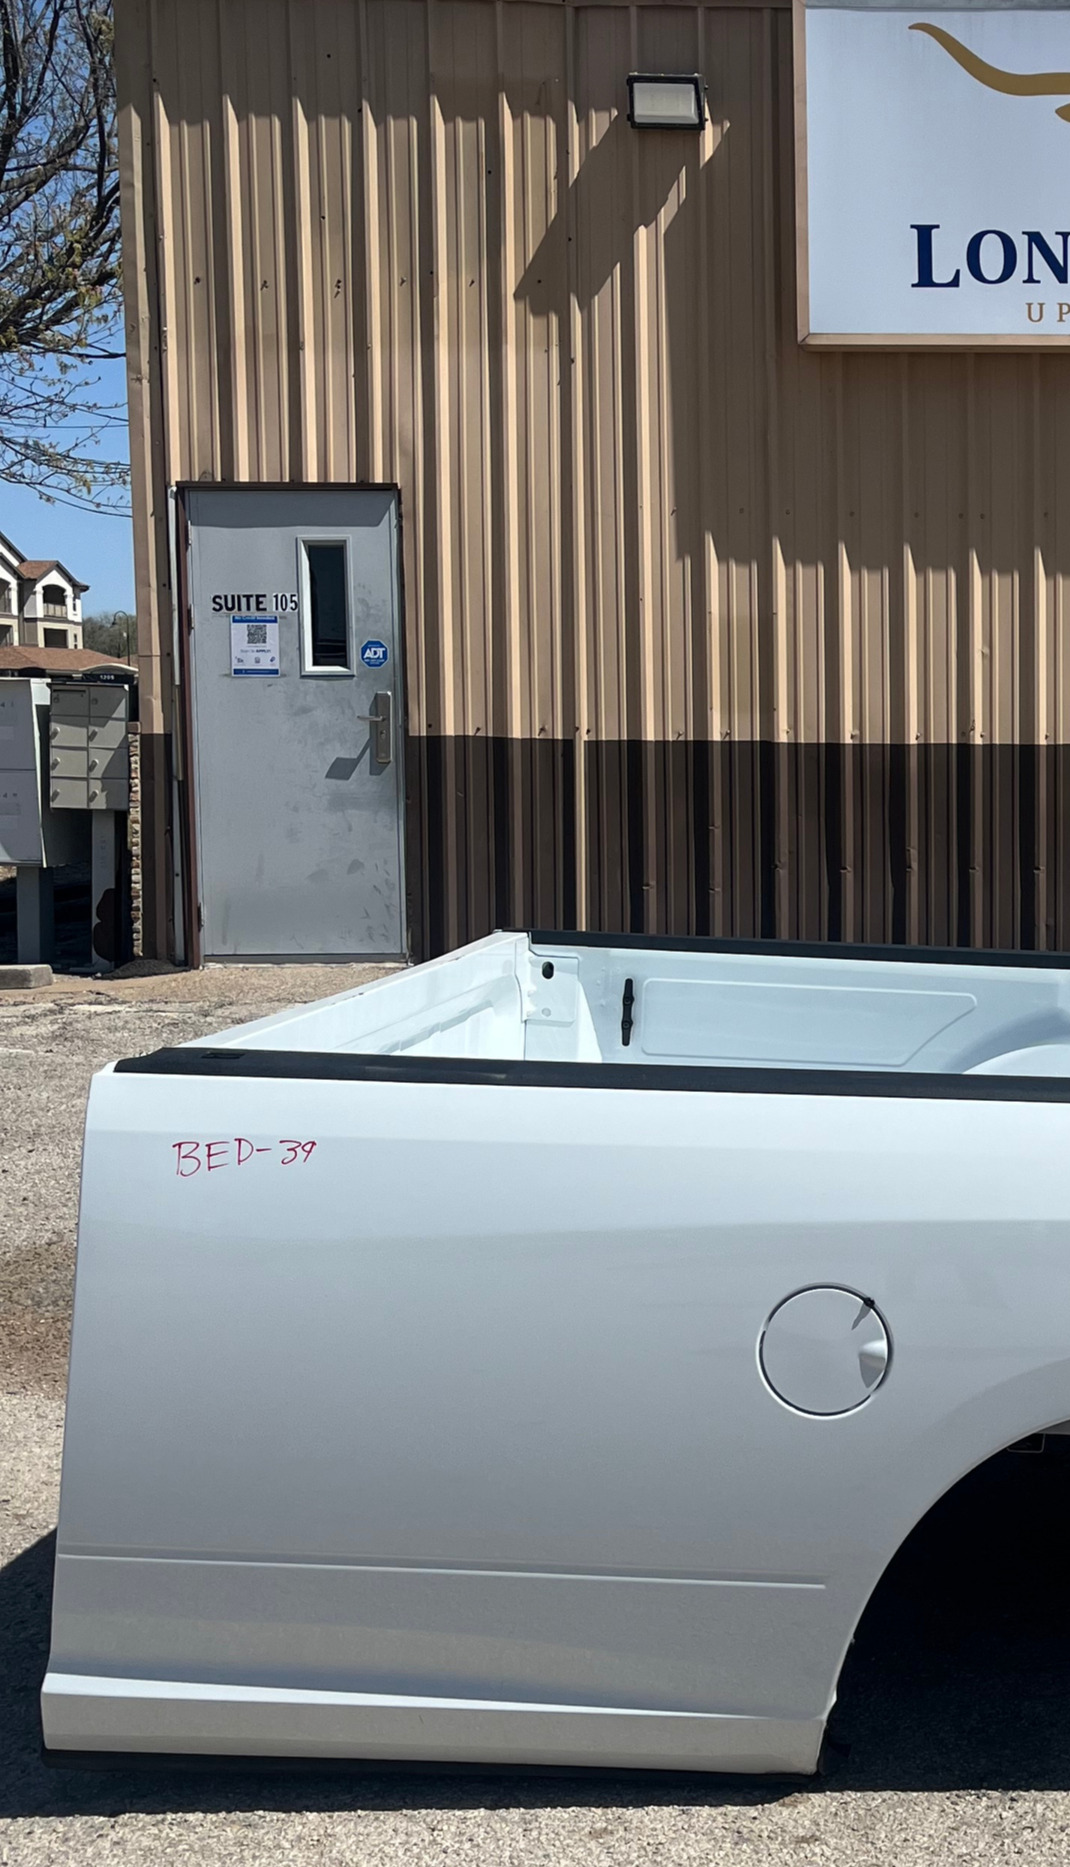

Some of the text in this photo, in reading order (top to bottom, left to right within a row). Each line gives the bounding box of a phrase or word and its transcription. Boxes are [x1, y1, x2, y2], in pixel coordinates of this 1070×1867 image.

[211, 593, 298, 612] SUITE 105
[363, 647, 386, 659] ADT
[172, 1138, 317, 1177] BED-39
